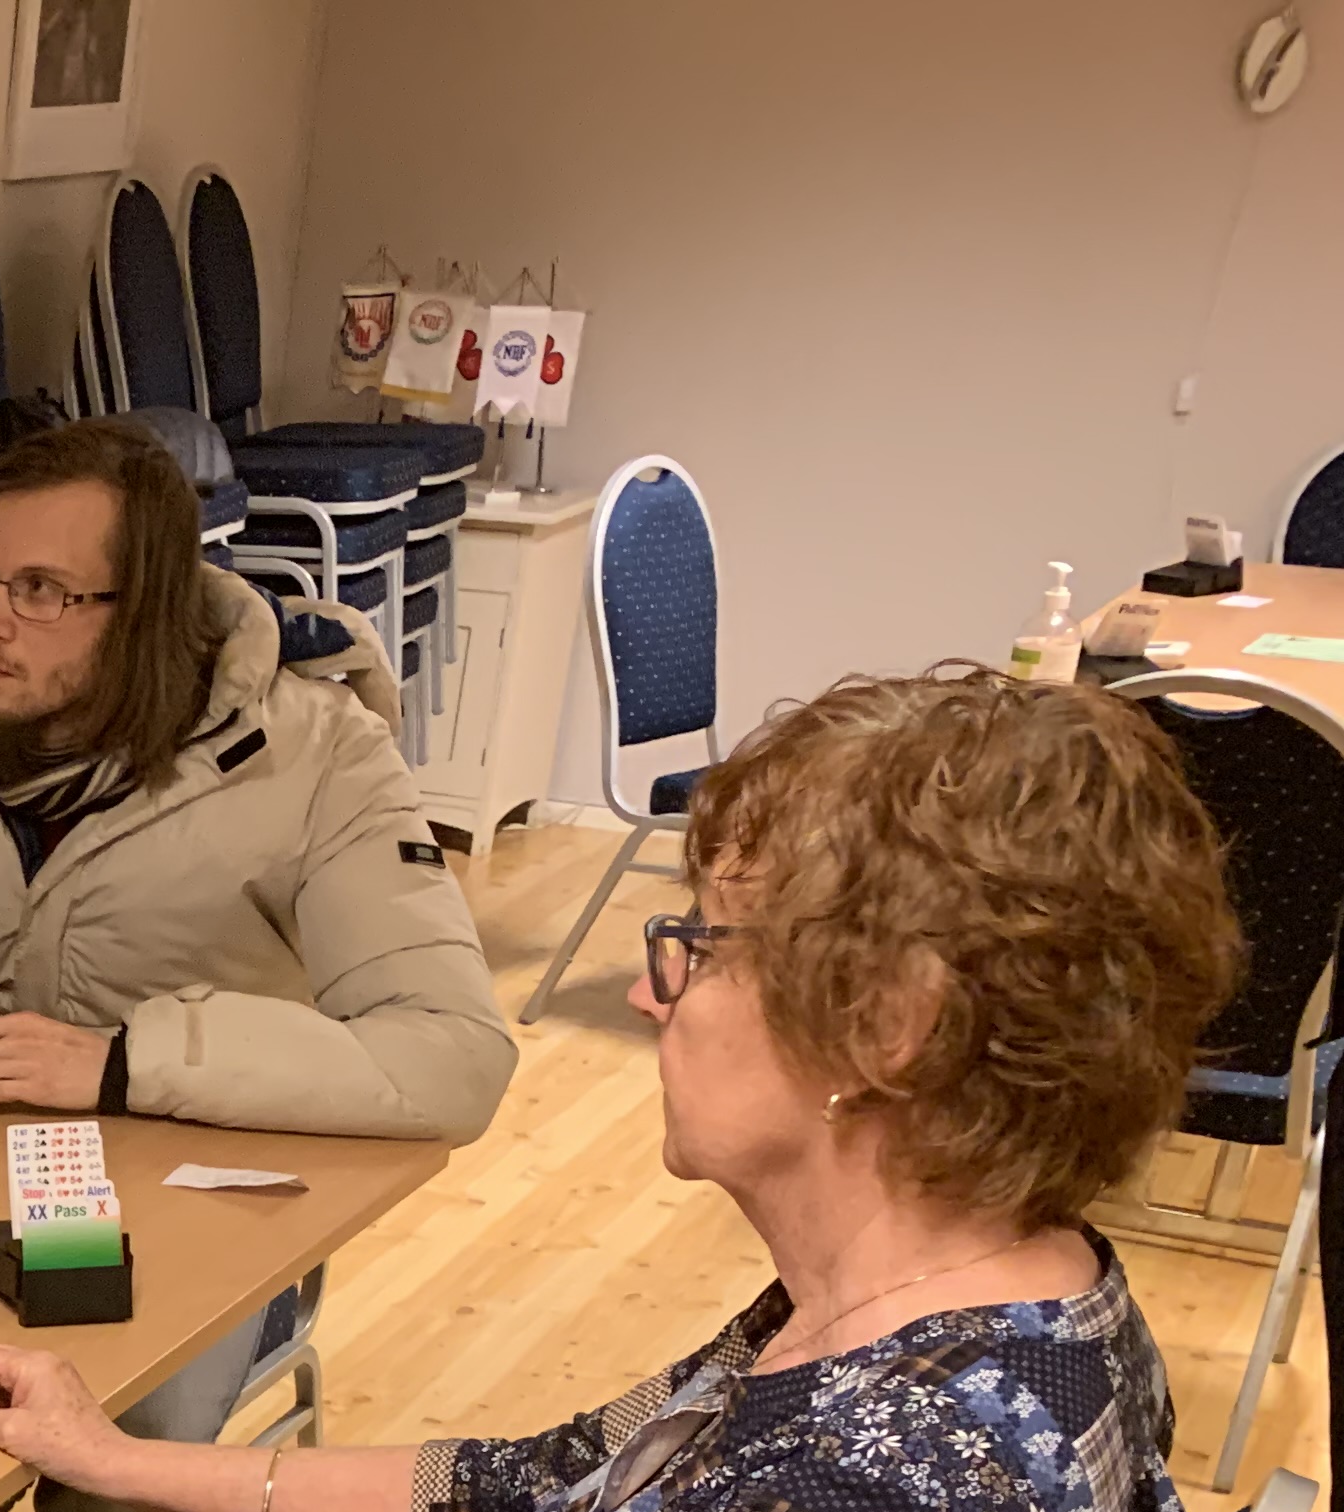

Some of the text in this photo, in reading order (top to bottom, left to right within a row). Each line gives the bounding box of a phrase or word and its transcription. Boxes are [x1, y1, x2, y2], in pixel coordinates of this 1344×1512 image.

[22, 1189, 45, 1199] Stop
[87, 1186, 111, 1196] Alert
[28, 1200, 107, 1220] XX Pass X
